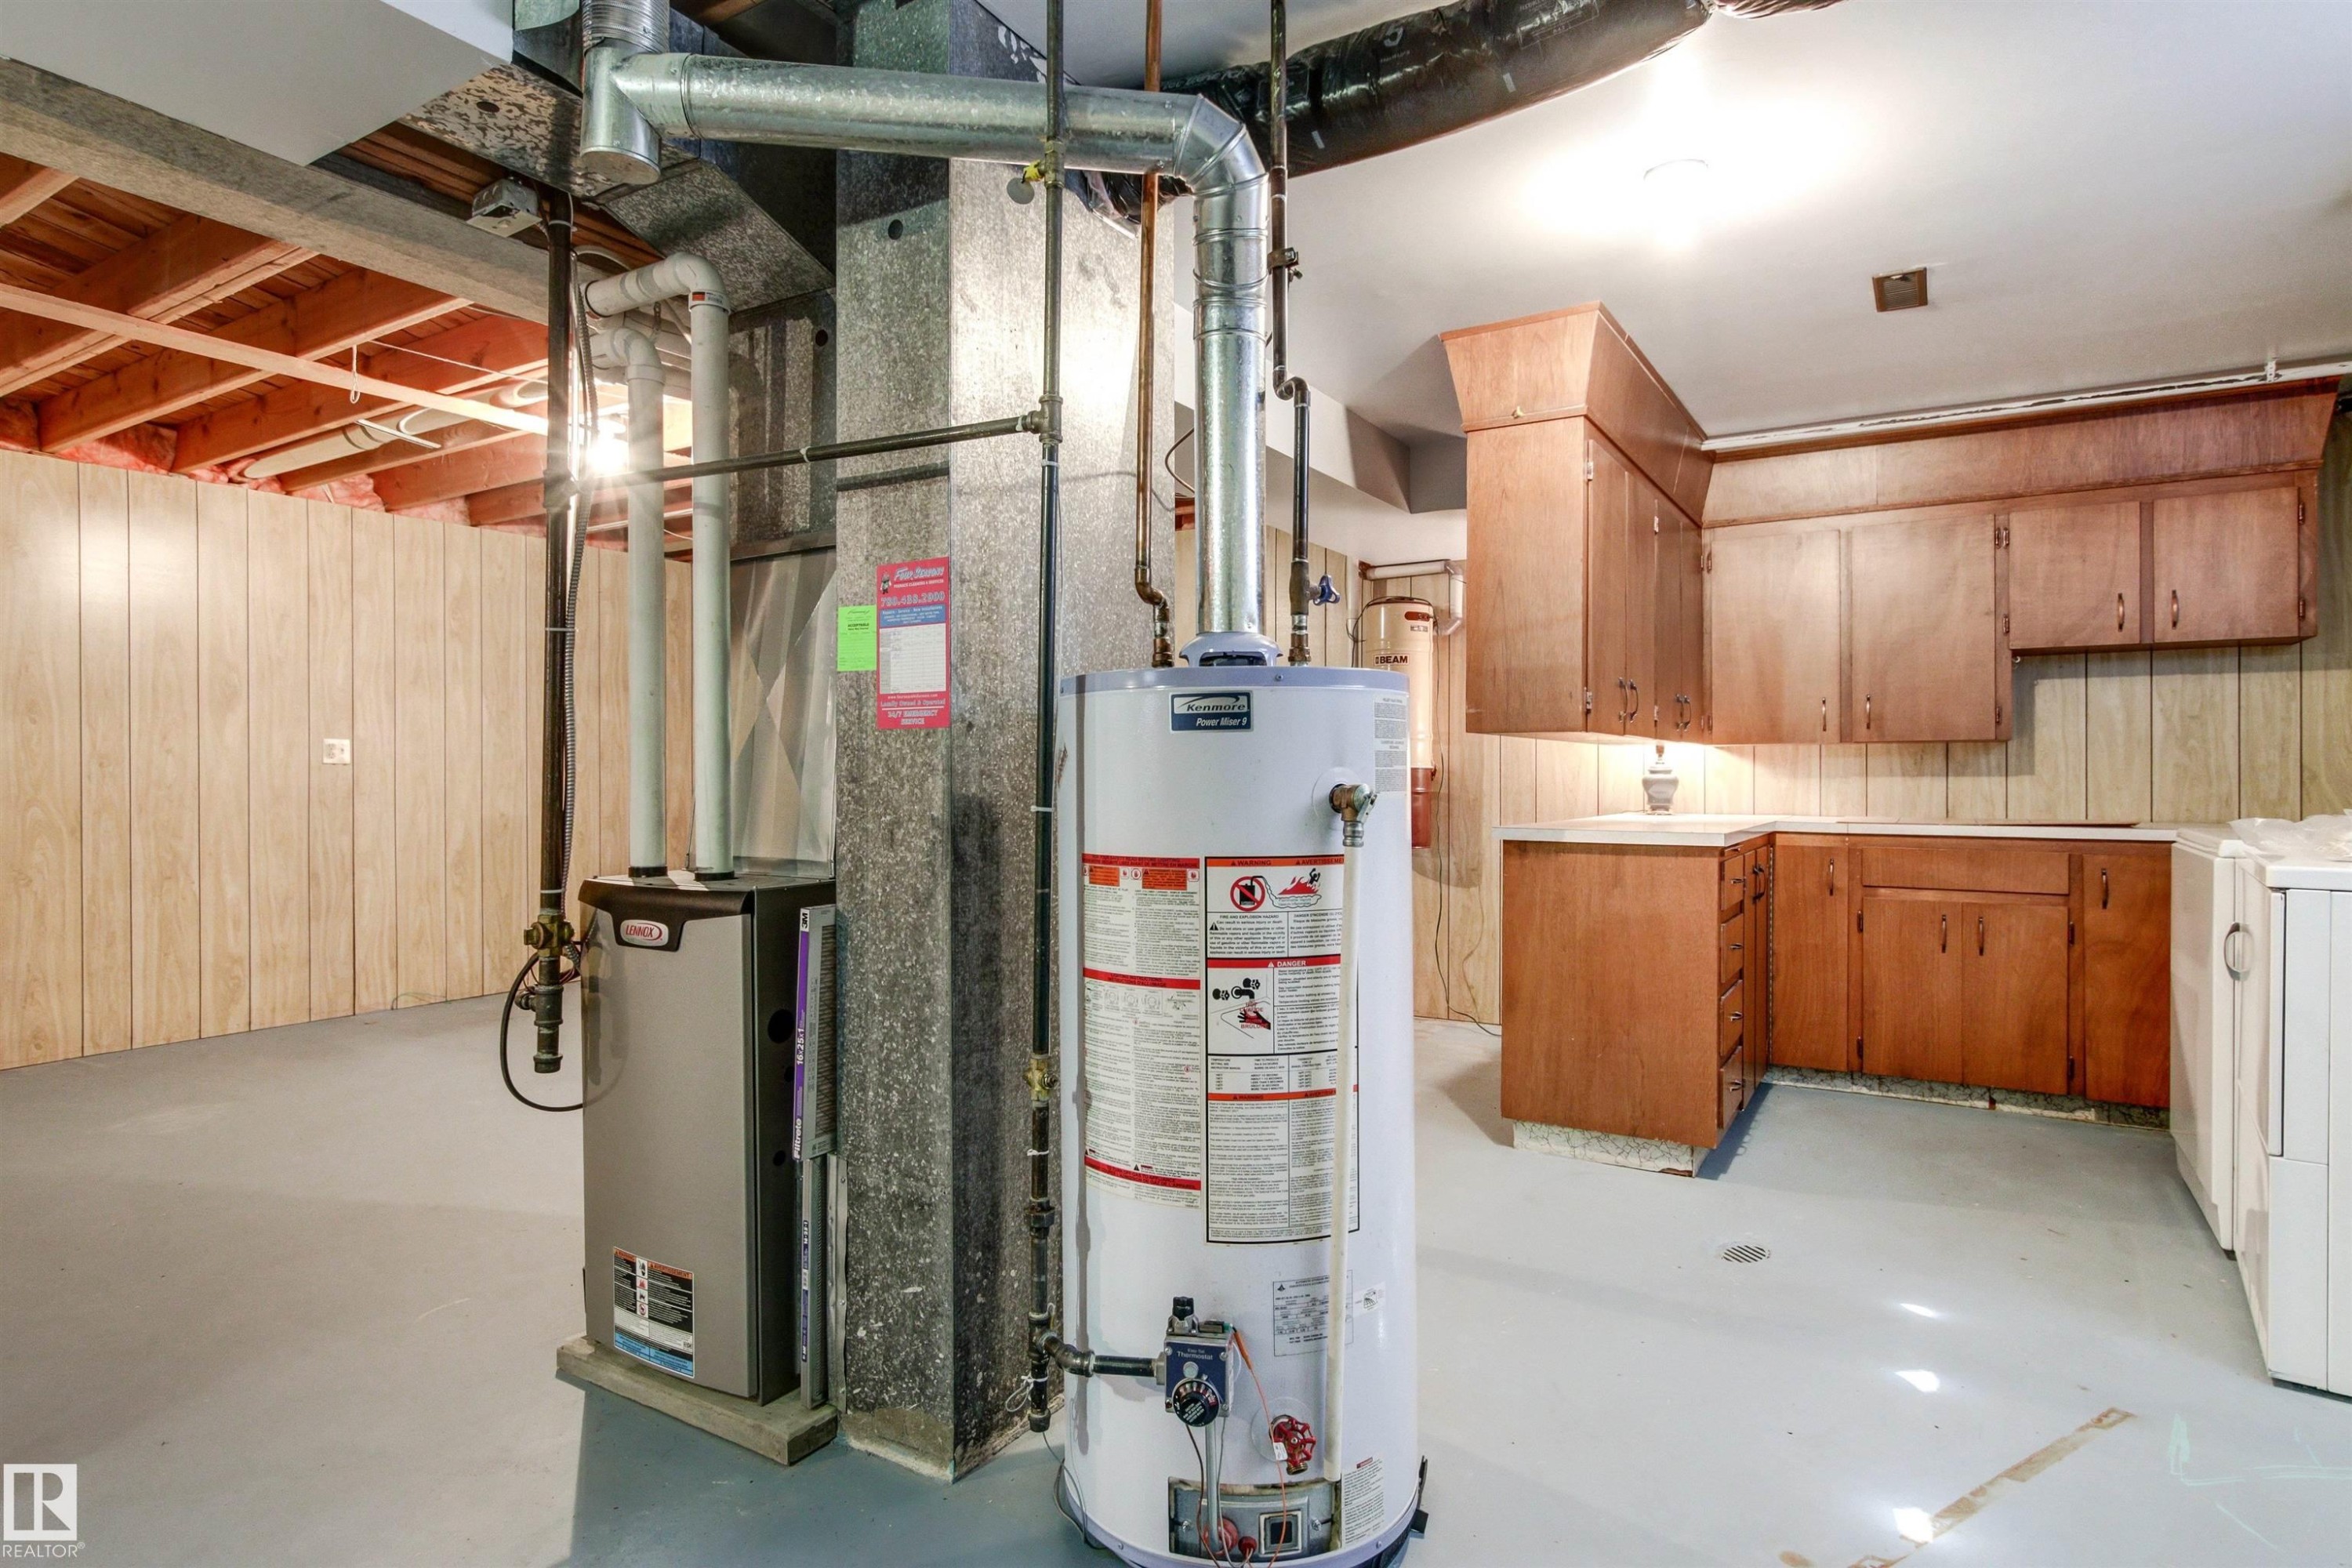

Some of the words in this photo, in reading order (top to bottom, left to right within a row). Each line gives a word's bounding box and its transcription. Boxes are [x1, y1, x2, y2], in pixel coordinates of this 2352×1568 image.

[1380, 655, 1407, 664] BEAM
[1220, 717, 1240, 726] Miser
[1242, 717, 1247, 726] 9
[802, 913, 808, 929] 3M
[626, 925, 654, 938] LENNOX
[793, 1118, 802, 1159] Filtrete
[1177, 1351, 1213, 1360] Thermostat
